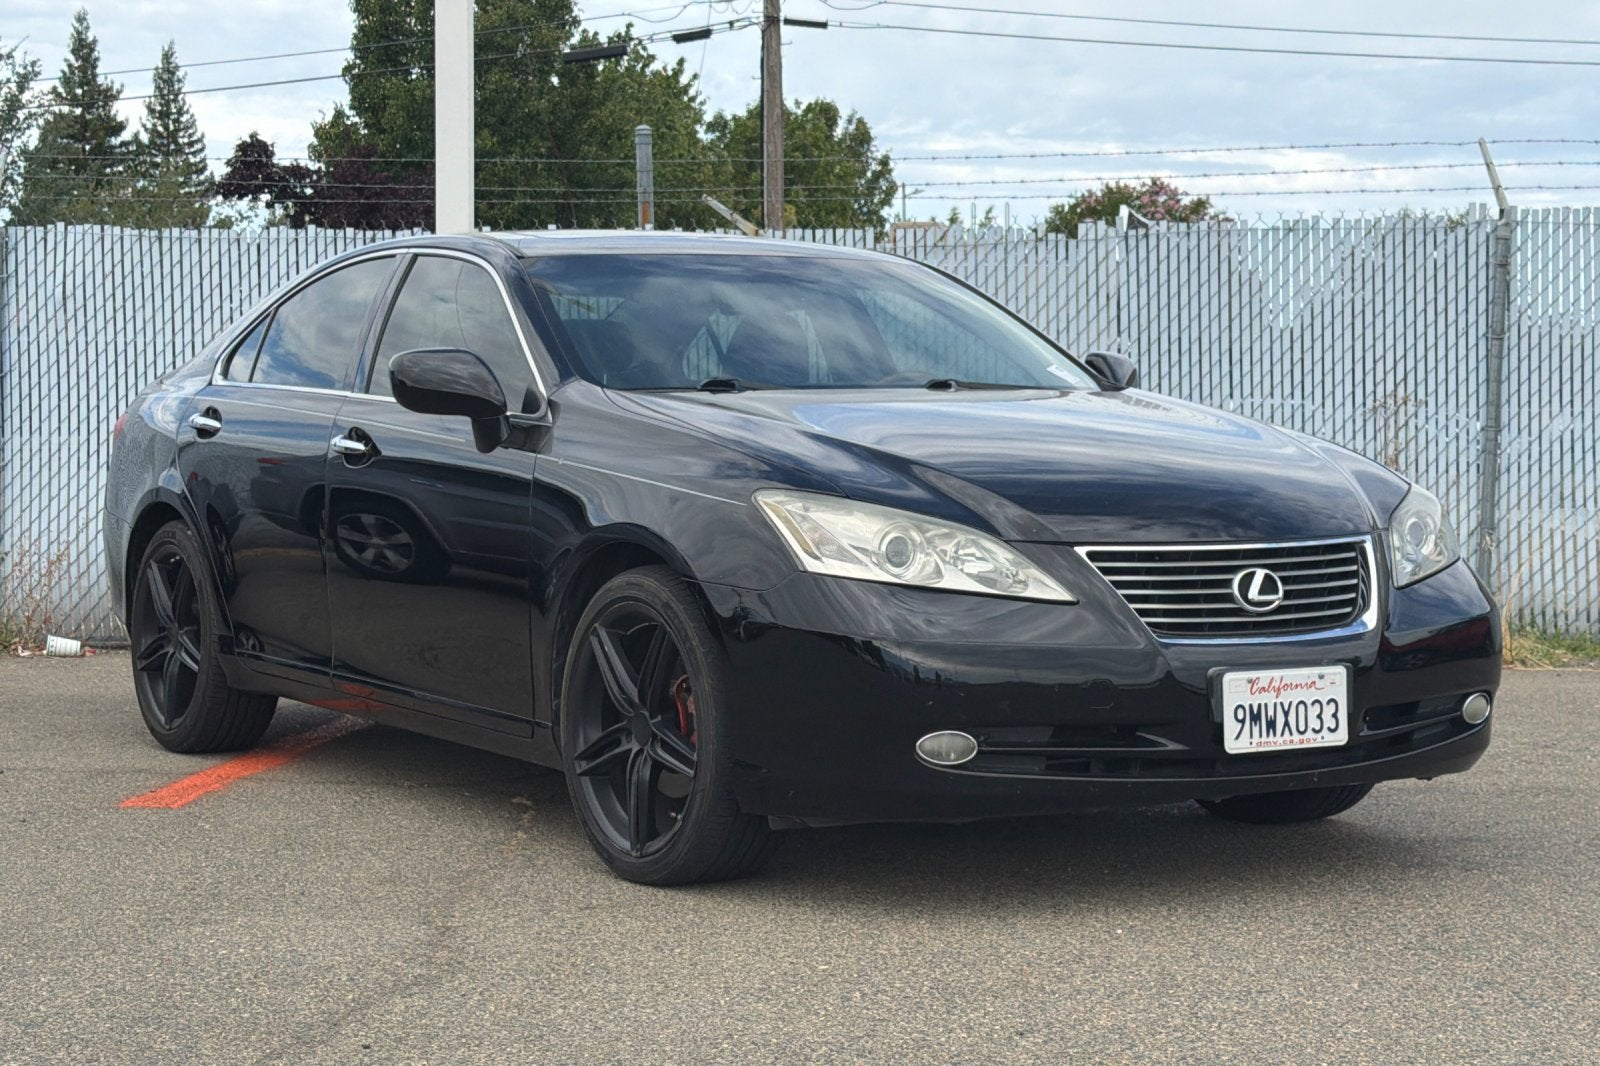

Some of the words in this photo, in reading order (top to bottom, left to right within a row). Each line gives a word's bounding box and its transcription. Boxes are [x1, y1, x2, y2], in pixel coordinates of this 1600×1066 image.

[1250, 675, 1324, 699] California
[1233, 698, 1340, 741] 9MWX033
[1256, 736, 1318, 747] dmv.ca.gov
